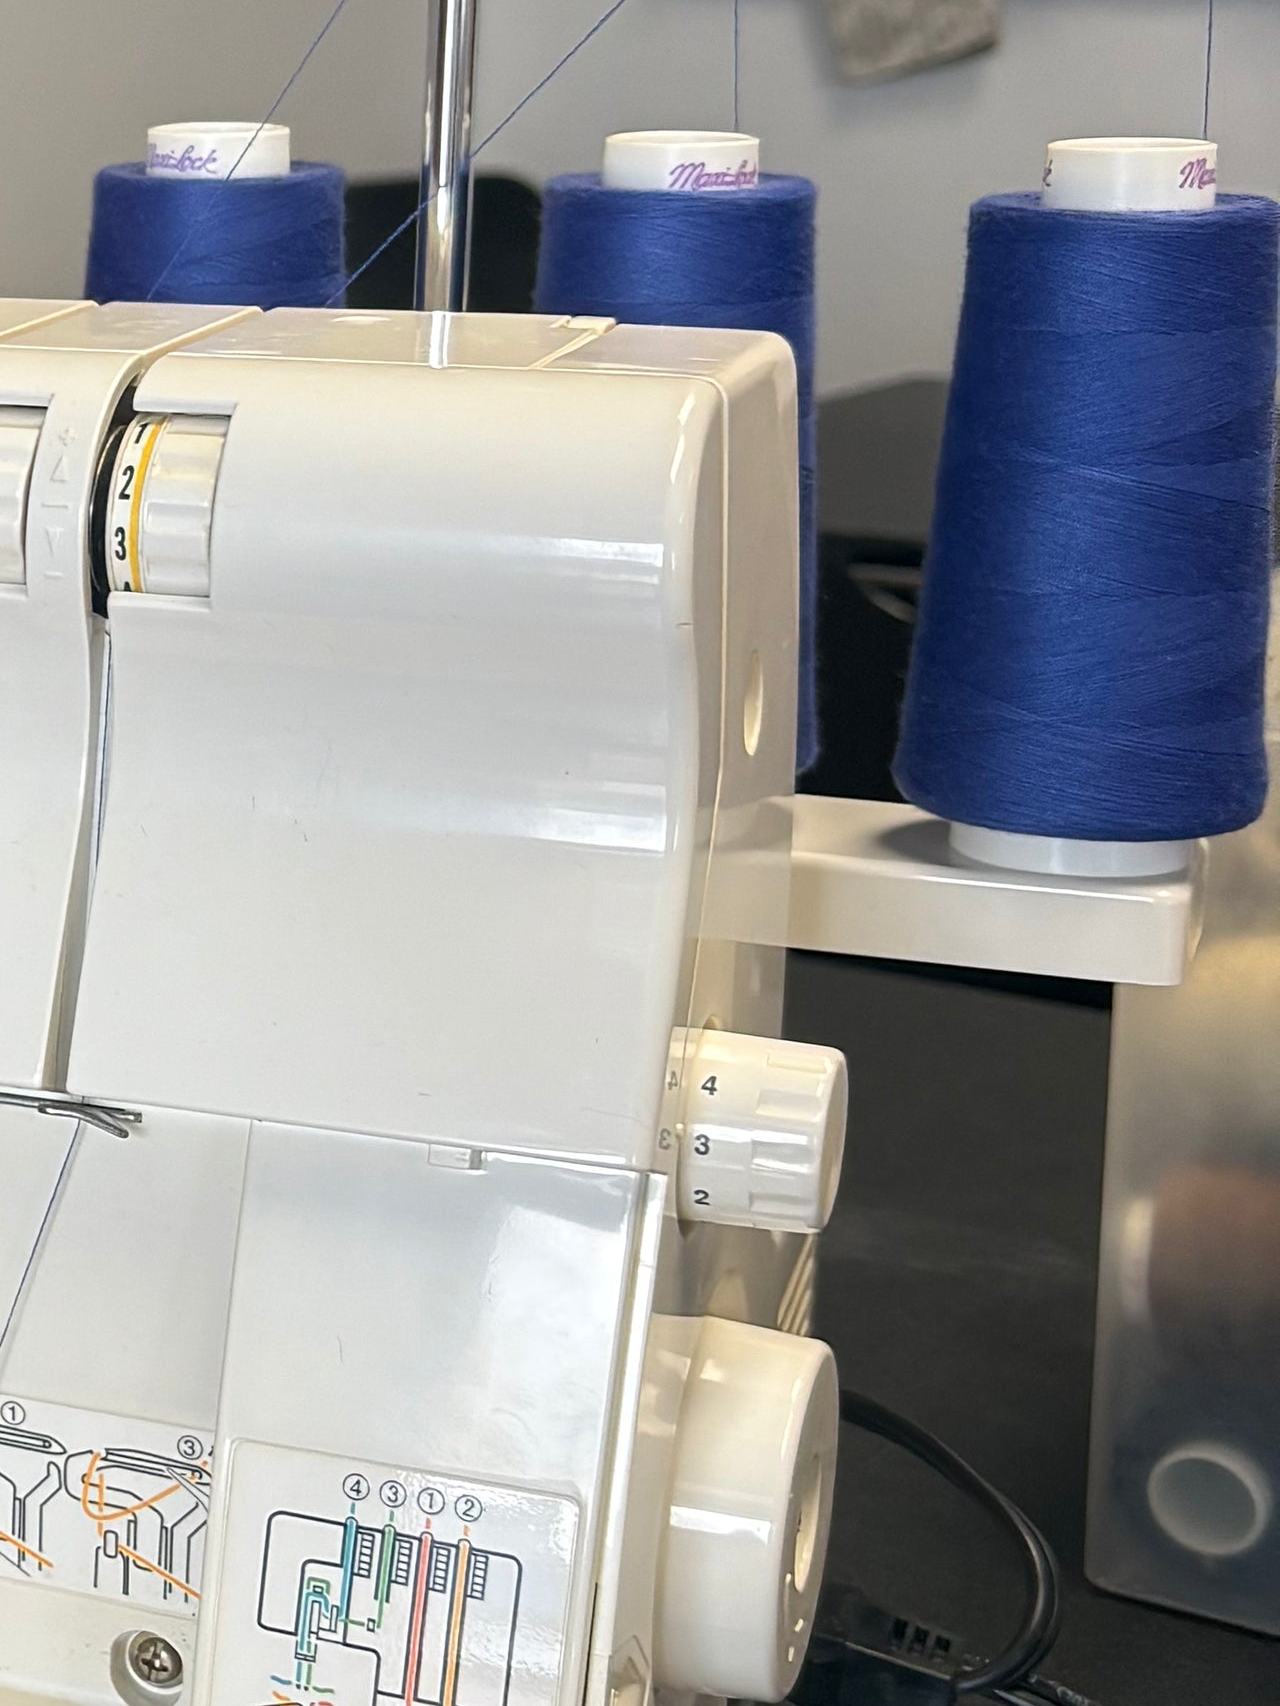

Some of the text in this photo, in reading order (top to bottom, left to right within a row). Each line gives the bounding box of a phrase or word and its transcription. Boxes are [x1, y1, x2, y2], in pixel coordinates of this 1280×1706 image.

[135, 424, 147, 444] 1
[118, 465, 134, 500] 2
[115, 527, 126, 560] 3
[701, 1075, 718, 1095] 4
[694, 1134, 710, 1155] 3
[694, 1189, 710, 1206] 2
